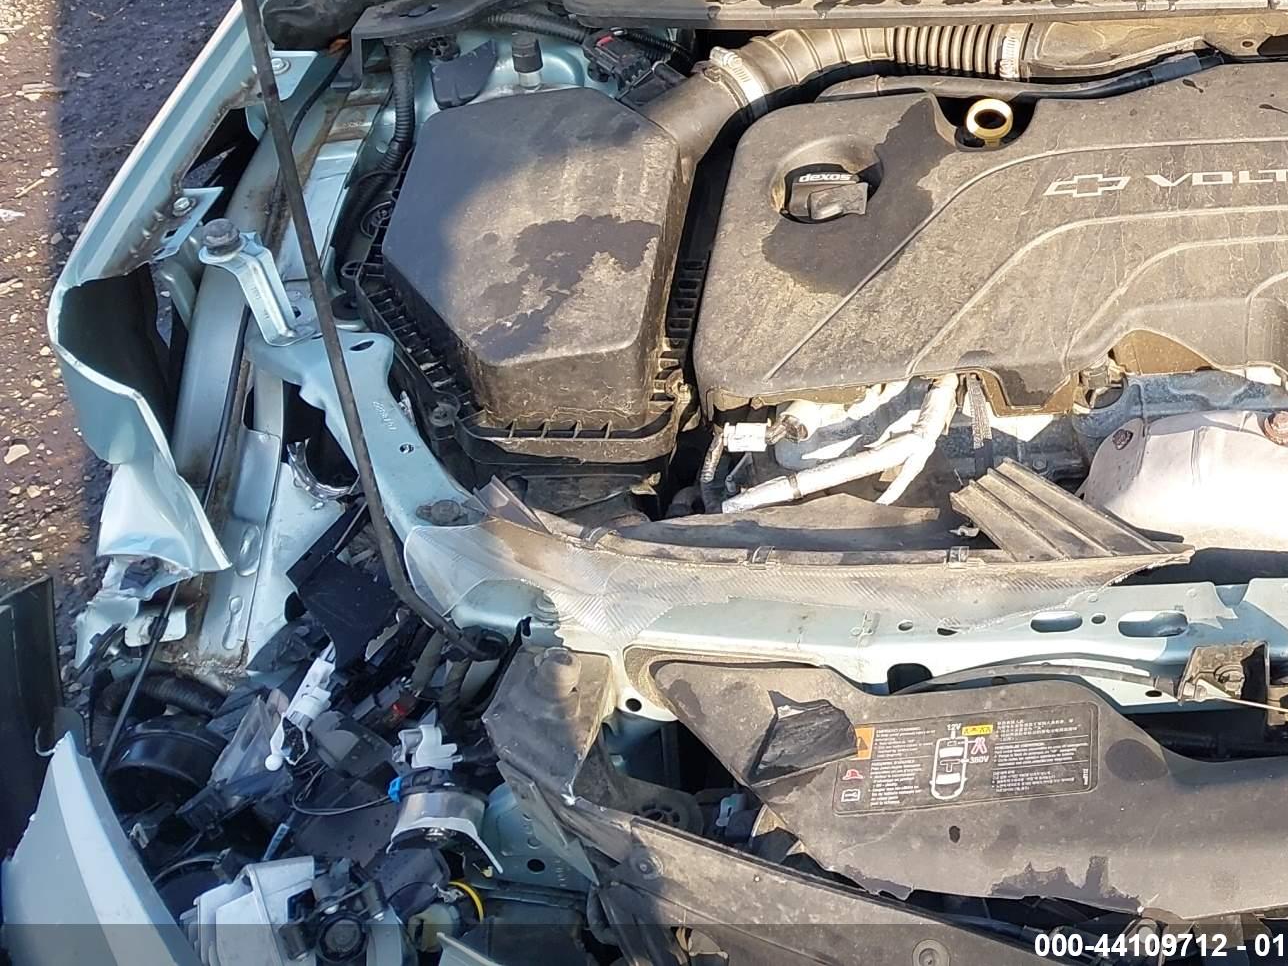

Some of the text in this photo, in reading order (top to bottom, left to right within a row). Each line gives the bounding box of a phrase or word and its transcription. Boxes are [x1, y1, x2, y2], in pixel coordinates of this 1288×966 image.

[799, 173, 854, 183] dexos
[946, 722, 961, 731] 12V
[969, 755, 990, 764] 360V
